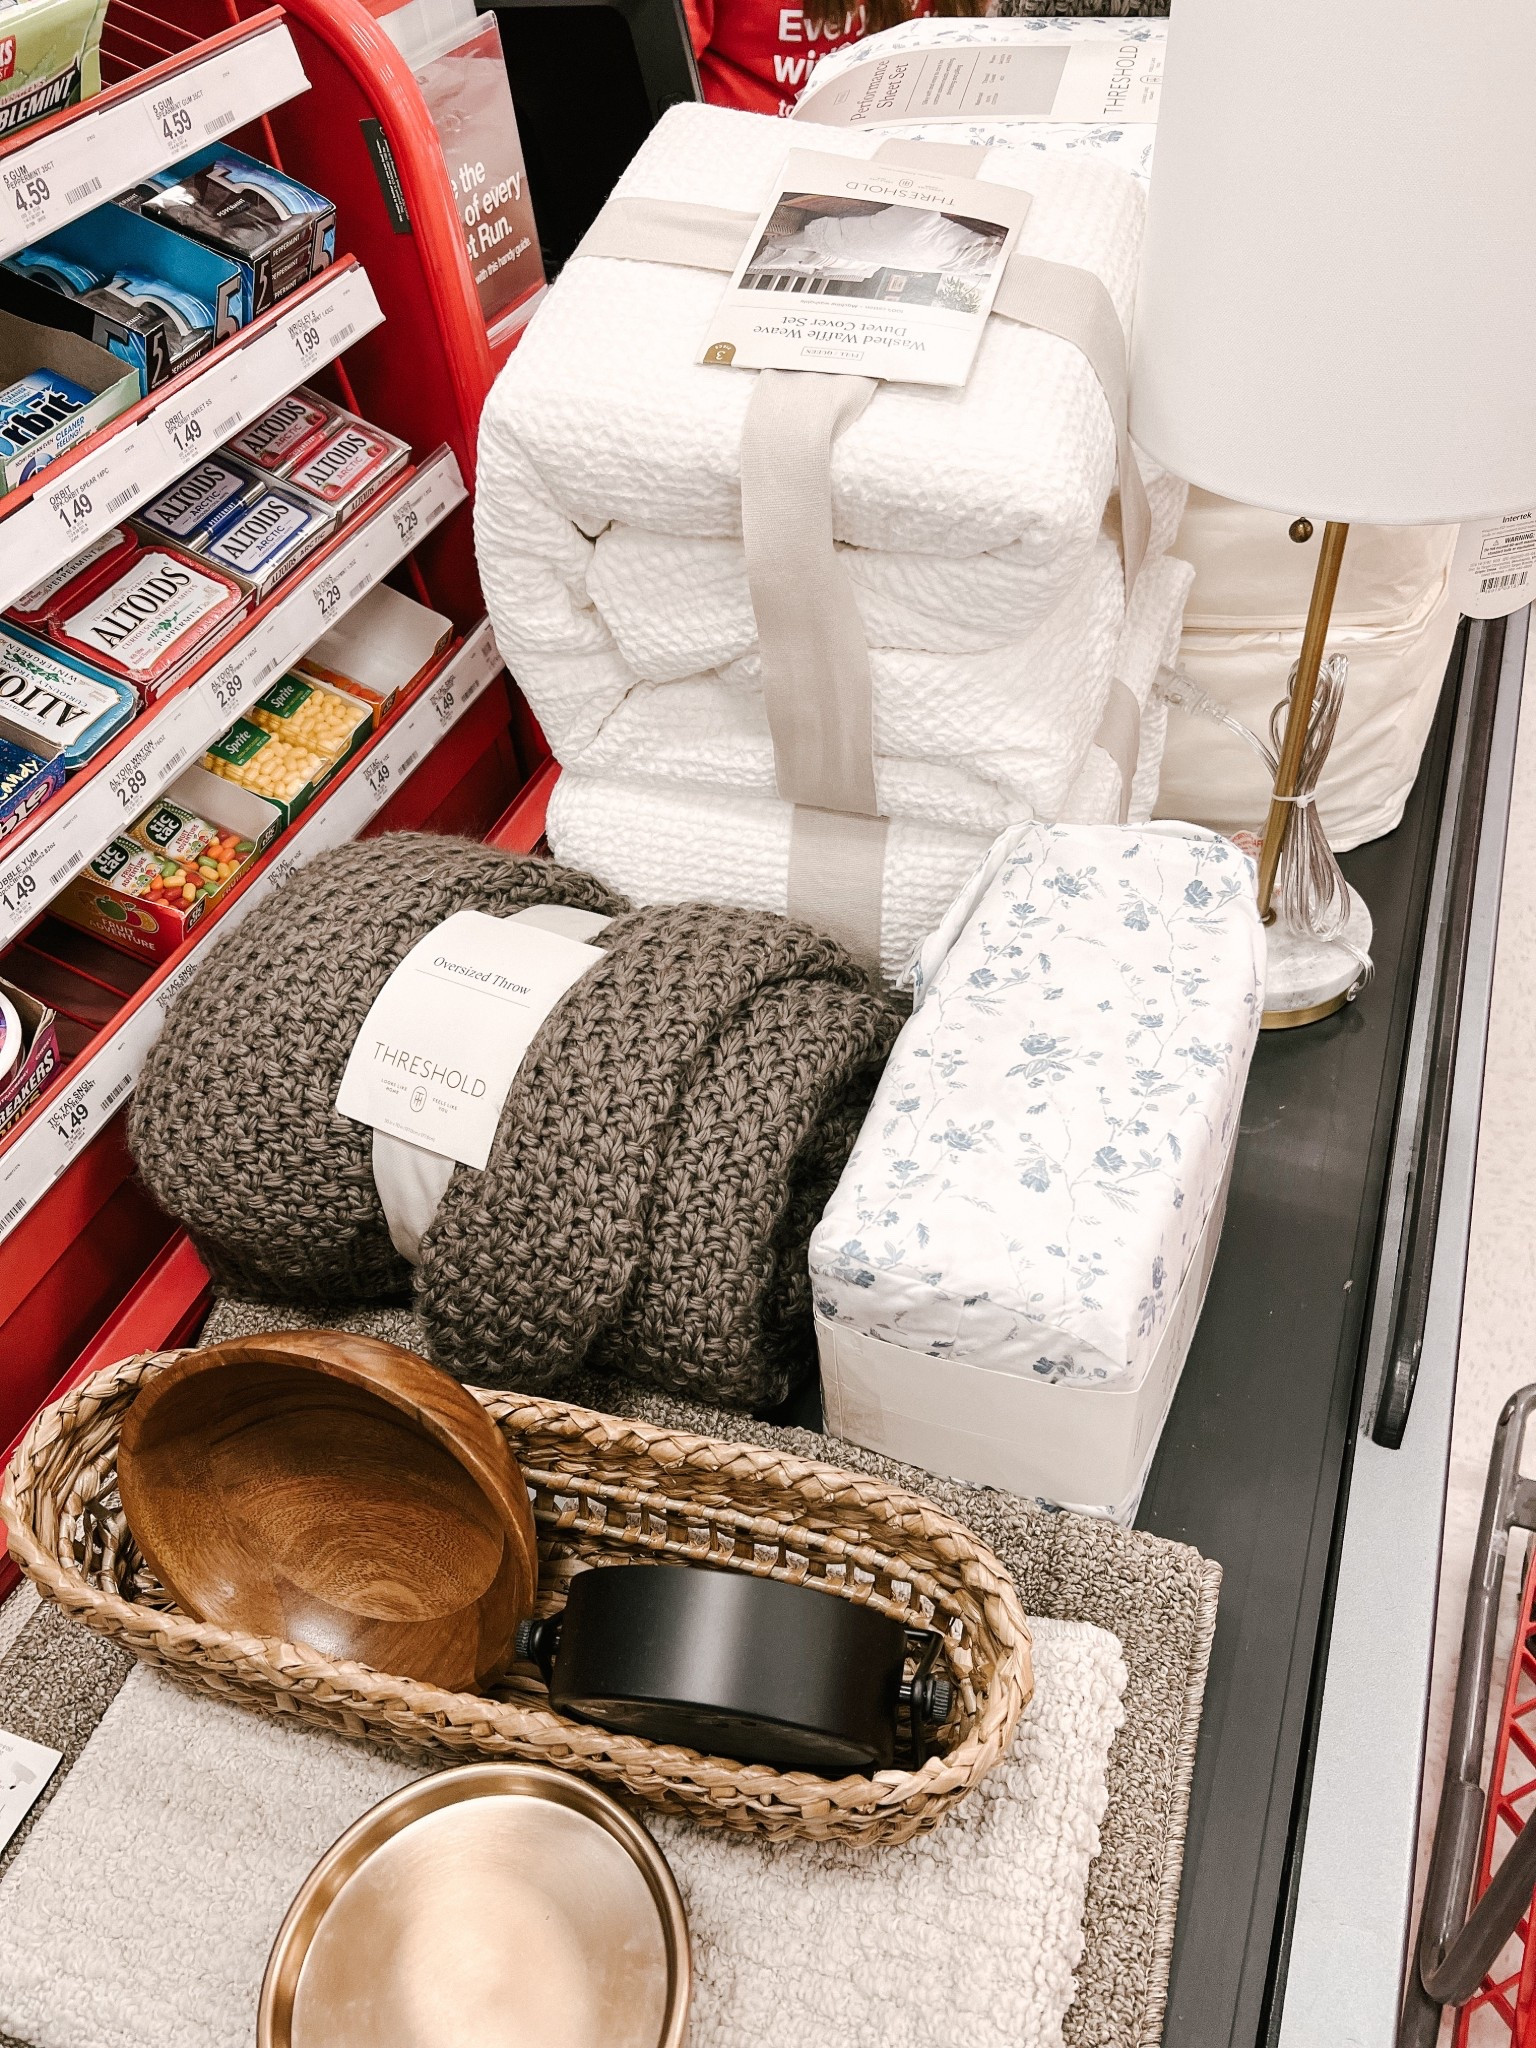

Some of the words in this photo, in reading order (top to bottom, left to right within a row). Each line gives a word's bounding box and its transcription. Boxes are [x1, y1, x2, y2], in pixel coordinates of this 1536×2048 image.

[850, 59, 890, 122] Performance
[876, 73, 899, 109] Sheet
[889, 62, 909, 81] Set
[1104, 45, 1138, 114] THRESHOLD
[152, 104, 159, 114] 5
[157, 96, 174, 111] GUM
[155, 101, 182, 120] SPEARMINT
[181, 96, 192, 108] GUM
[163, 109, 192, 139] 4.59
[2, 174, 10, 184] 5
[9, 164, 29, 181] GUM
[6, 168, 42, 192] PEPPERMINT
[459, 161, 486, 193] the
[15, 177, 50, 211] 4.59
[464, 192, 481, 227] of
[482, 171, 521, 214] every
[845, 181, 955, 206] THRESHOLD
[272, 233, 300, 257] PEPPERMINT
[477, 216, 513, 253] Run.
[474, 268, 489, 285] with
[487, 261, 499, 276] this
[497, 248, 517, 268] handy
[287, 310, 312, 334] WRIGLEY
[311, 310, 316, 318] 5
[753, 325, 802, 340] Weave
[782, 315, 808, 327] Set
[809, 317, 856, 332] Cover
[861, 323, 907, 338] Duvet
[295, 327, 320, 355] 1.99
[807, 330, 858, 344] Waffle
[862, 334, 926, 352] Washed
[715, 349, 727, 361] 3
[165, 410, 184, 430] ORBIT
[190, 402, 206, 418] SWEET
[55, 416, 85, 441] CLEANER
[173, 419, 202, 450] 1.49
[241, 400, 306, 454] ALTOIDS
[274, 424, 302, 448] ARCTIC
[42, 438, 55, 449] EVEN
[304, 433, 367, 487] ALTOIDS
[336, 456, 363, 480] ARCTIC
[49, 484, 71, 506] ORBIT
[79, 476, 98, 493] SPEAR
[153, 466, 226, 526] ALTOIDS
[59, 493, 93, 528] 1.49
[189, 490, 221, 517] ARCTIC
[350, 484, 375, 513] ALTOIDS
[220, 500, 290, 560] ALTOIDS
[397, 511, 418, 538] 2.29
[1502, 511, 1532, 523] Intertek
[255, 525, 286, 552] ARCTIC
[1504, 533, 1536, 544] WARNING:
[46, 549, 98, 591] PEPPERMINT
[270, 558, 297, 586] ALTOIDS
[299, 530, 326, 557] ARCTIC
[90, 566, 191, 649] ALTOIDS
[104, 594, 127, 613] Original
[318, 585, 341, 615] 2.29
[121, 619, 156, 650] CURIOUSLY
[154, 600, 180, 621] STRONG
[178, 584, 199, 601] MINTS
[156, 605, 204, 647] PEPPERMINT
[7, 643, 78, 683] WINTERGREEN
[211, 663, 234, 690] ALTOIDS
[0, 667, 91, 727] ALTO
[39, 680, 88, 708] CURIOUSLY
[216, 674, 242, 708] 2.89
[270, 685, 295, 709] Sprite
[435, 692, 455, 717] 1.49
[225, 730, 251, 755] Sprite
[109, 763, 132, 786] ALTOID
[130, 739, 155, 764] WNTGN
[116, 769, 147, 807] 2.89
[370, 764, 390, 791] 1.49
[149, 813, 171, 834] tic
[155, 820, 180, 842] tac
[176, 829, 189, 845] FRUIT
[176, 824, 200, 853] ADVENTURE
[21, 849, 39, 867] YUM
[95, 846, 117, 865] tic
[99, 852, 126, 875] tac
[121, 862, 135, 879] FRUIT
[121, 856, 147, 888] ADVENTURE
[267, 871, 280, 883] TIC
[276, 859, 288, 873] TAC
[2, 874, 36, 911] 1.49
[89, 919, 156, 951] ADVENTURE
[101, 917, 135, 936] FRUIT
[156, 990, 169, 1004] TIC
[166, 979, 180, 994] TAC
[178, 963, 196, 979] SNGL
[433, 955, 492, 983] Oversized
[491, 973, 532, 996] Throw
[373, 1041, 487, 1098] THRESHOLD
[47, 1111, 62, 1127] TIC
[59, 1096, 74, 1114] TAC
[72, 1079, 92, 1097] SNGL
[50, 1120, 61, 1130] TIC
[59, 1109, 71, 1121] TAC
[69, 1093, 85, 1111] FRESH
[84, 1079, 96, 1095] MINT
[57, 1103, 89, 1139] 1.49
